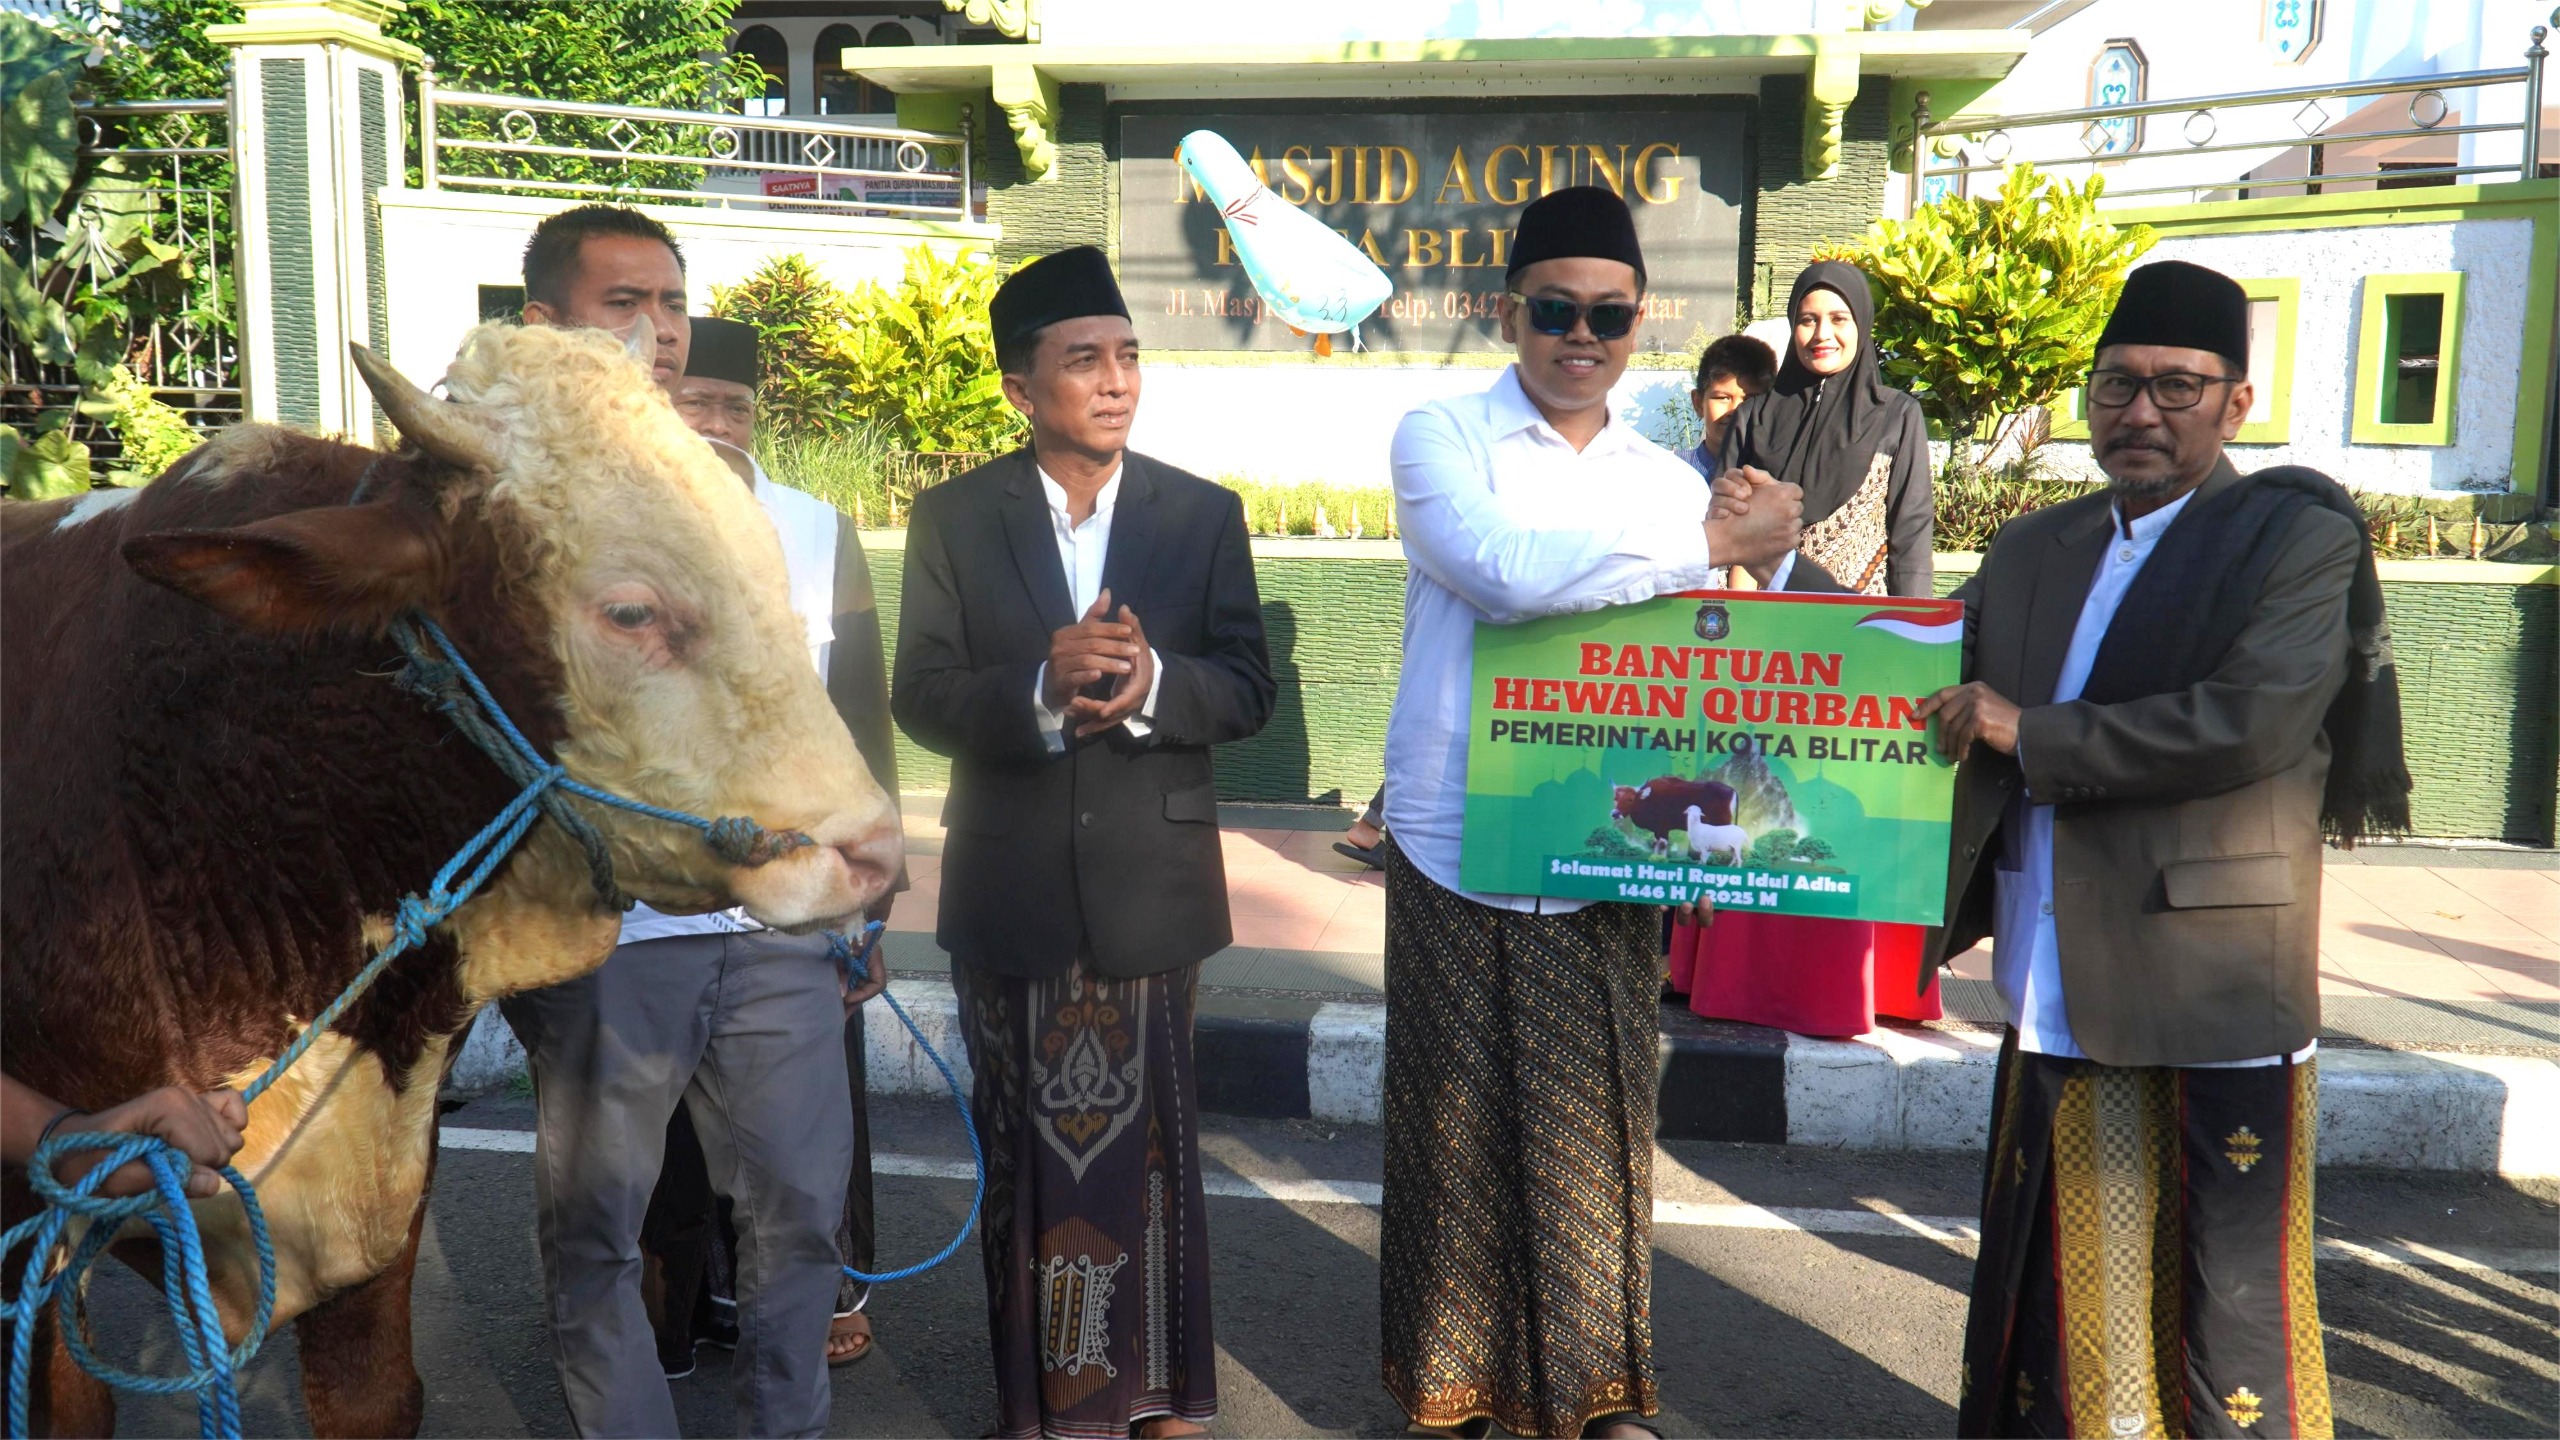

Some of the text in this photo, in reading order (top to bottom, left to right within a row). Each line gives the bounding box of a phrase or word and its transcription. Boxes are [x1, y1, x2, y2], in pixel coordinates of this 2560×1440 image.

[771, 181, 811, 193] SAATNYA
[865, 180, 892, 189] PANITIA
[892, 180, 920, 190] QURBAN
[921, 180, 945, 190] MASJID
[1434, 142, 1685, 206] AGUNG
[1403, 228, 1517, 267] BLI
[1165, 289, 1195, 317] Jl.
[1579, 642, 1844, 687] BANTUAN
[1493, 677, 1928, 731] HEWAN QURBAN
[1490, 719, 1928, 765] PEMERINTAH KOTA BLITAR
[1551, 859, 1852, 894] Selamat Hari Raya Idul Adha
[1618, 883, 1779, 907] 1446 H / 2025 M
